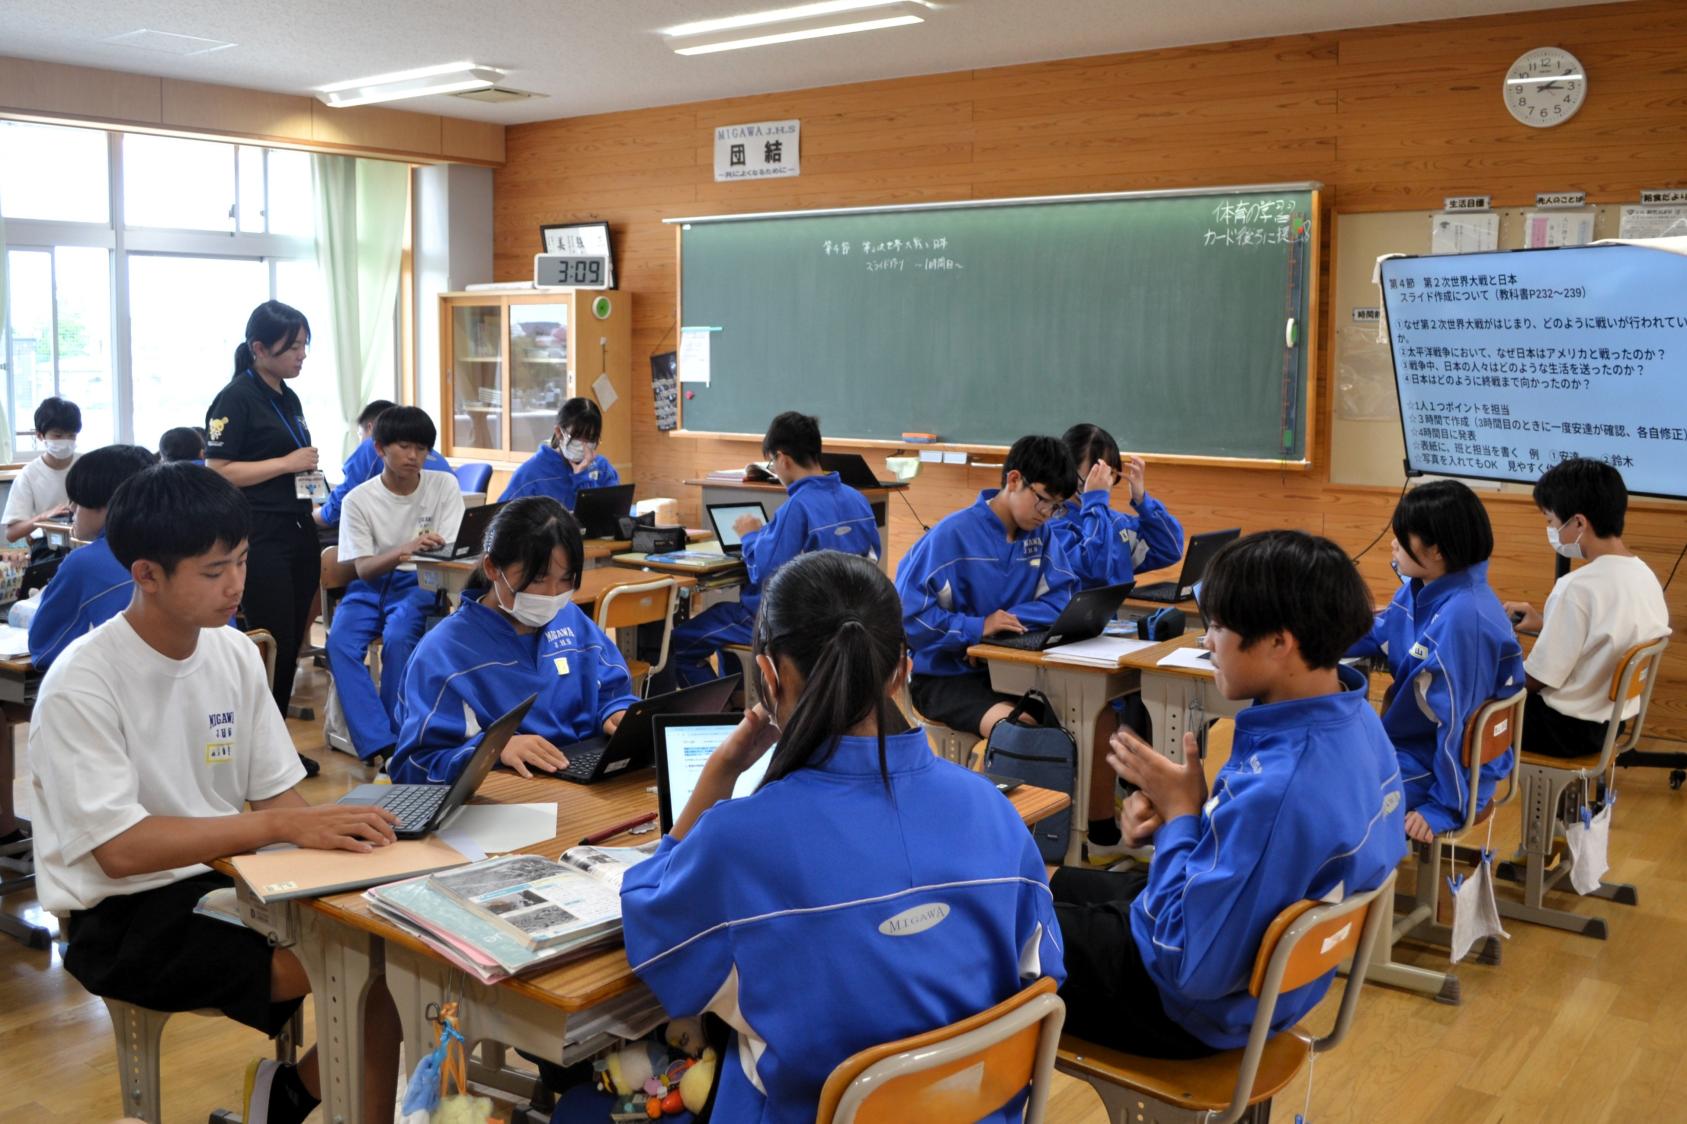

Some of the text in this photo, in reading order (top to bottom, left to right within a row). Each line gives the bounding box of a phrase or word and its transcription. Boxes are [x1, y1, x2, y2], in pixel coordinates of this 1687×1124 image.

[1528, 63, 1537, 71] 11
[1541, 58, 1551, 67] 12
[1515, 85, 1523, 94] 9
[1567, 81, 1575, 90] 3
[1519, 97, 1526, 106] 8
[1563, 95, 1571, 103] 4
[1528, 106, 1535, 115] 7
[1540, 108, 1548, 118] 6
[1554, 105, 1562, 114] 5
[718, 126, 763, 140] MIGAWA
[1449, 199, 1485, 209] 生活目標
[557, 260, 600, 283] 3:09
[1389, 272, 1518, 290] 第4節 第2次世界大戦と日本
[888, 905, 946, 934] MIGAWA
